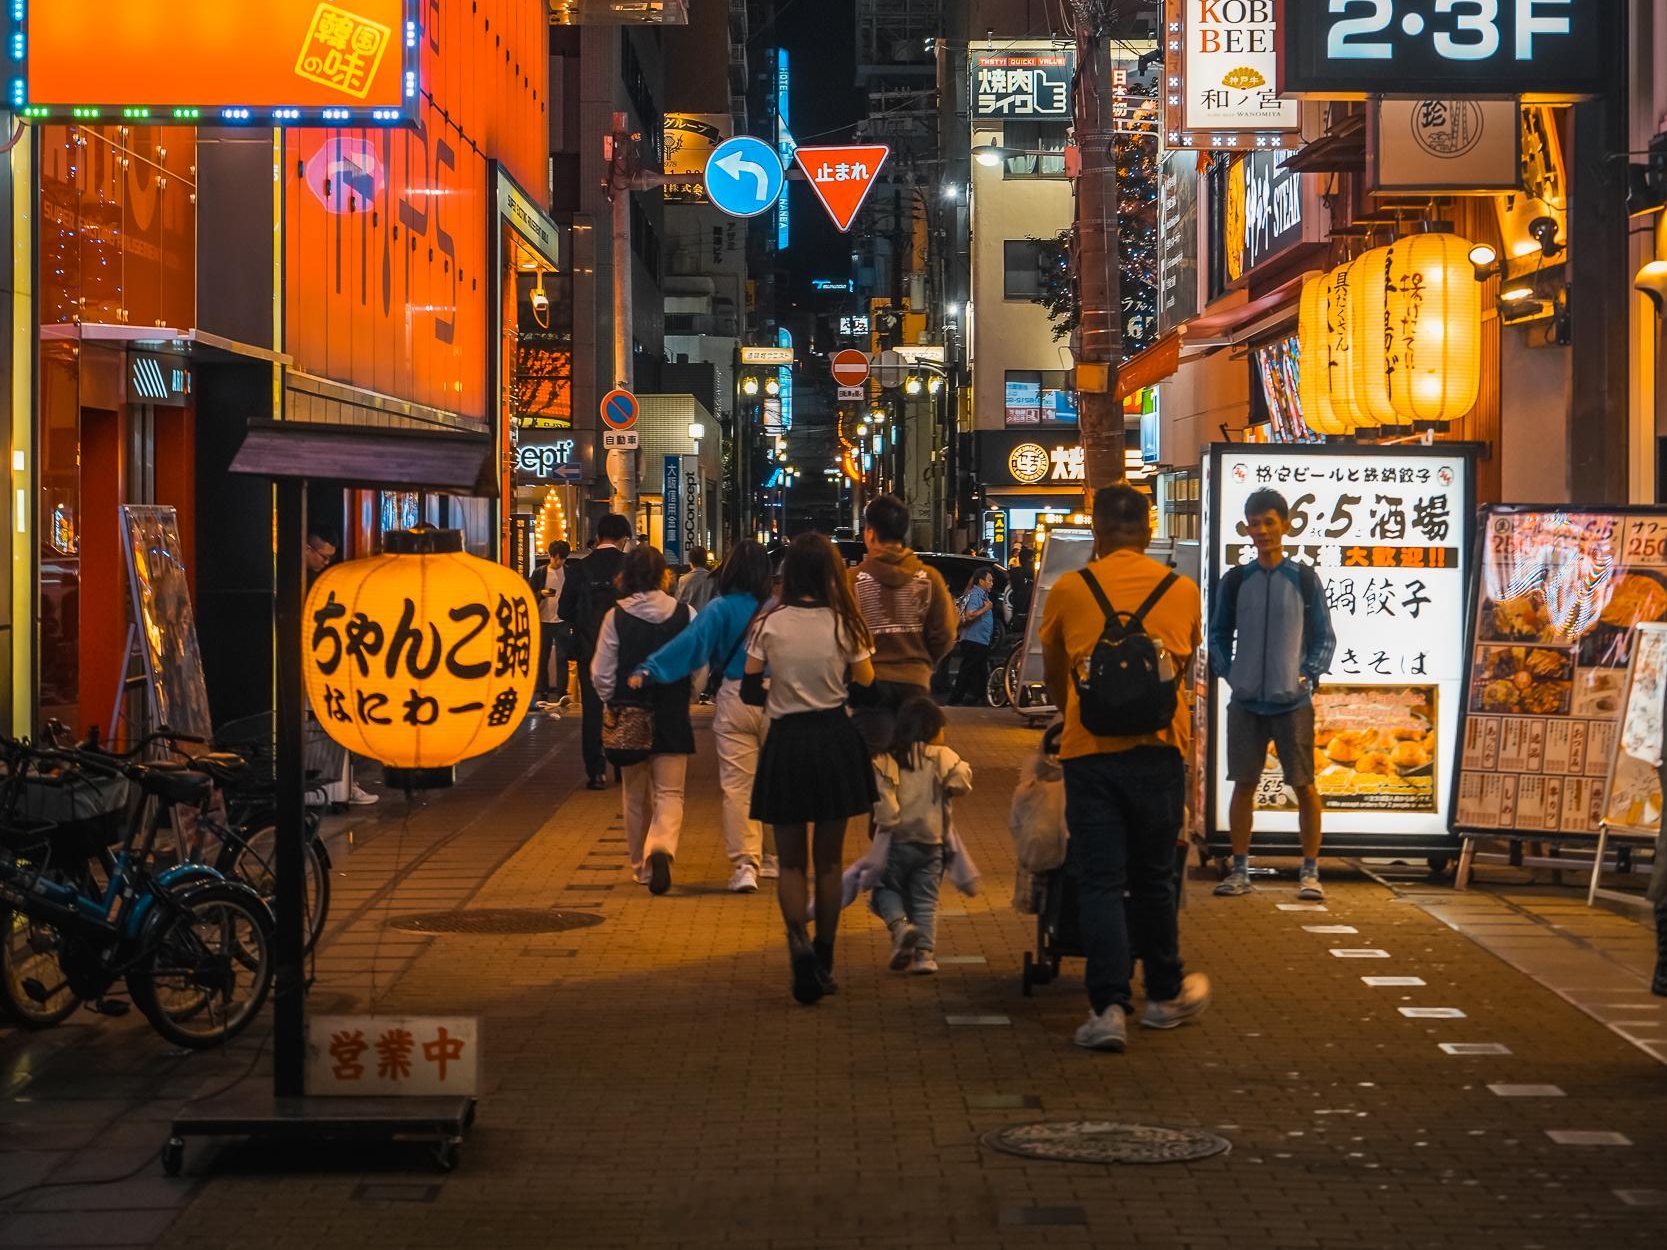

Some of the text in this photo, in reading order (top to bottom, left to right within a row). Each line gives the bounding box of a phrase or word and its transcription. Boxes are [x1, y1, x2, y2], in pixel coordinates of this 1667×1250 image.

[1010, 58, 1035, 66] QUICK!
[978, 68, 1034, 94] 焼肉
[978, 94, 1034, 114] ライク
[1200, 88, 1283, 110] 和ノ宮
[815, 161, 870, 184] 止まれ
[1273, 172, 1302, 238] STEAK
[605, 435, 637, 446] 自動車
[1255, 464, 1432, 484] 格安ビールと鉄鍋餃子
[684, 471, 699, 551] BoConcept
[312, 590, 532, 680] ちゃんこ鍋
[323, 683, 518, 728] なにわ一番
[328, 1026, 465, 1082] 営業中
